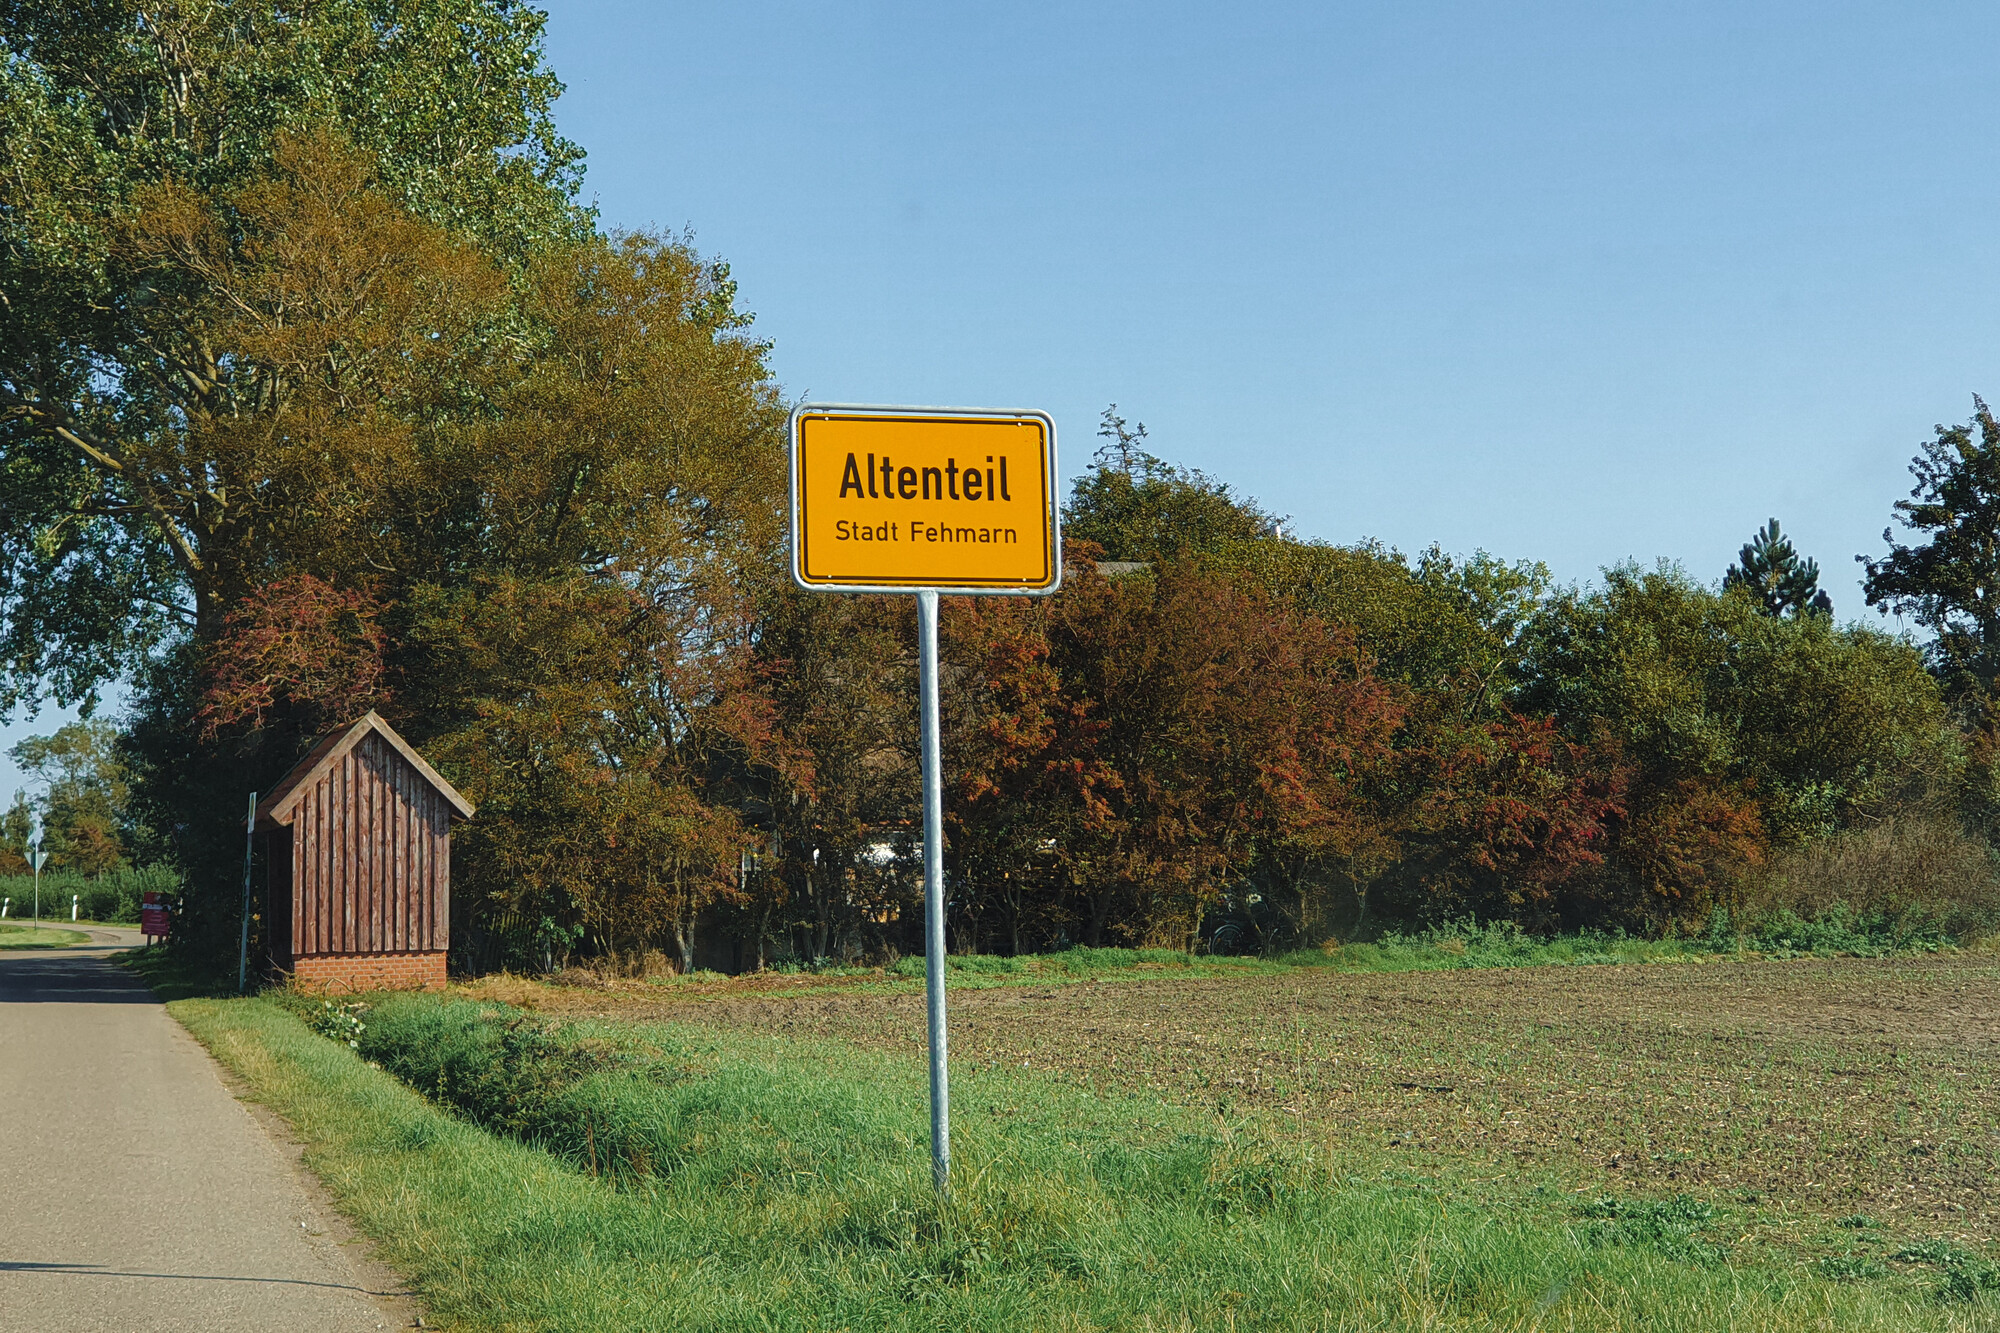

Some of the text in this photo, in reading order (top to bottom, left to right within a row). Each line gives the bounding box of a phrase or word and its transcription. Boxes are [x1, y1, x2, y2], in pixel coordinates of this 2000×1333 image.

[839, 452, 1011, 501] Altenteil
[835, 520, 1017, 543] Stadt Fehmarn
